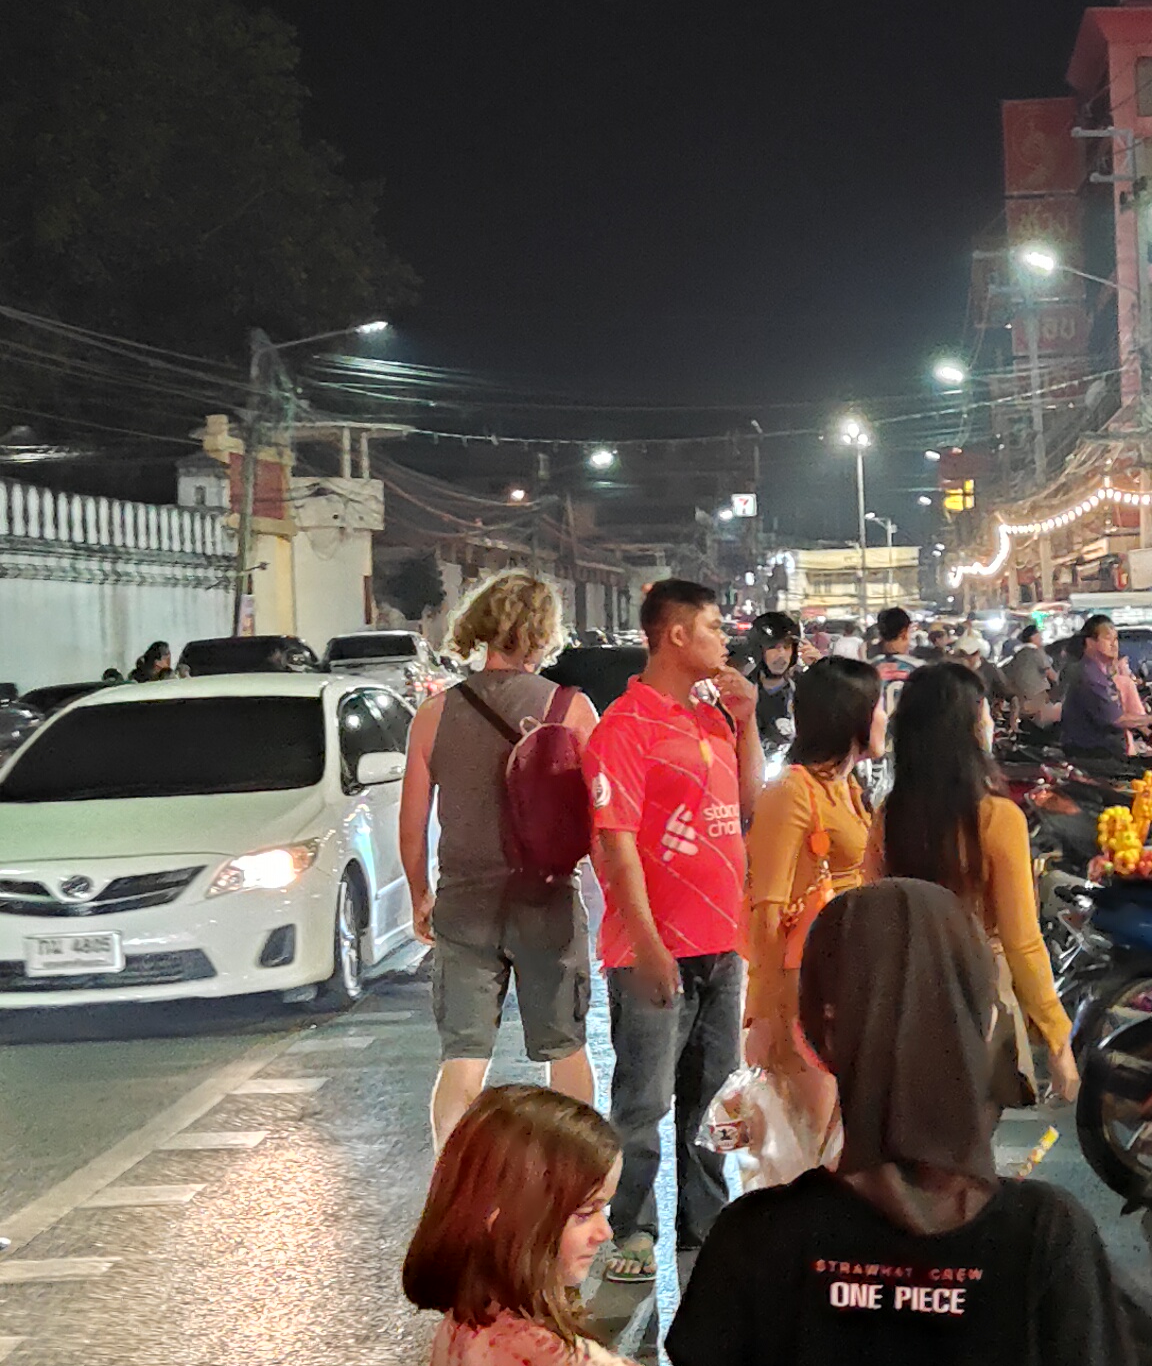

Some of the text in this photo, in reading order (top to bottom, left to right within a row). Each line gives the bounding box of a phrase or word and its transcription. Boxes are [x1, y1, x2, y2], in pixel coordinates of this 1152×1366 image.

[929, 1267, 984, 1283] CREW
[829, 1281, 967, 1315] ONE PIECE
